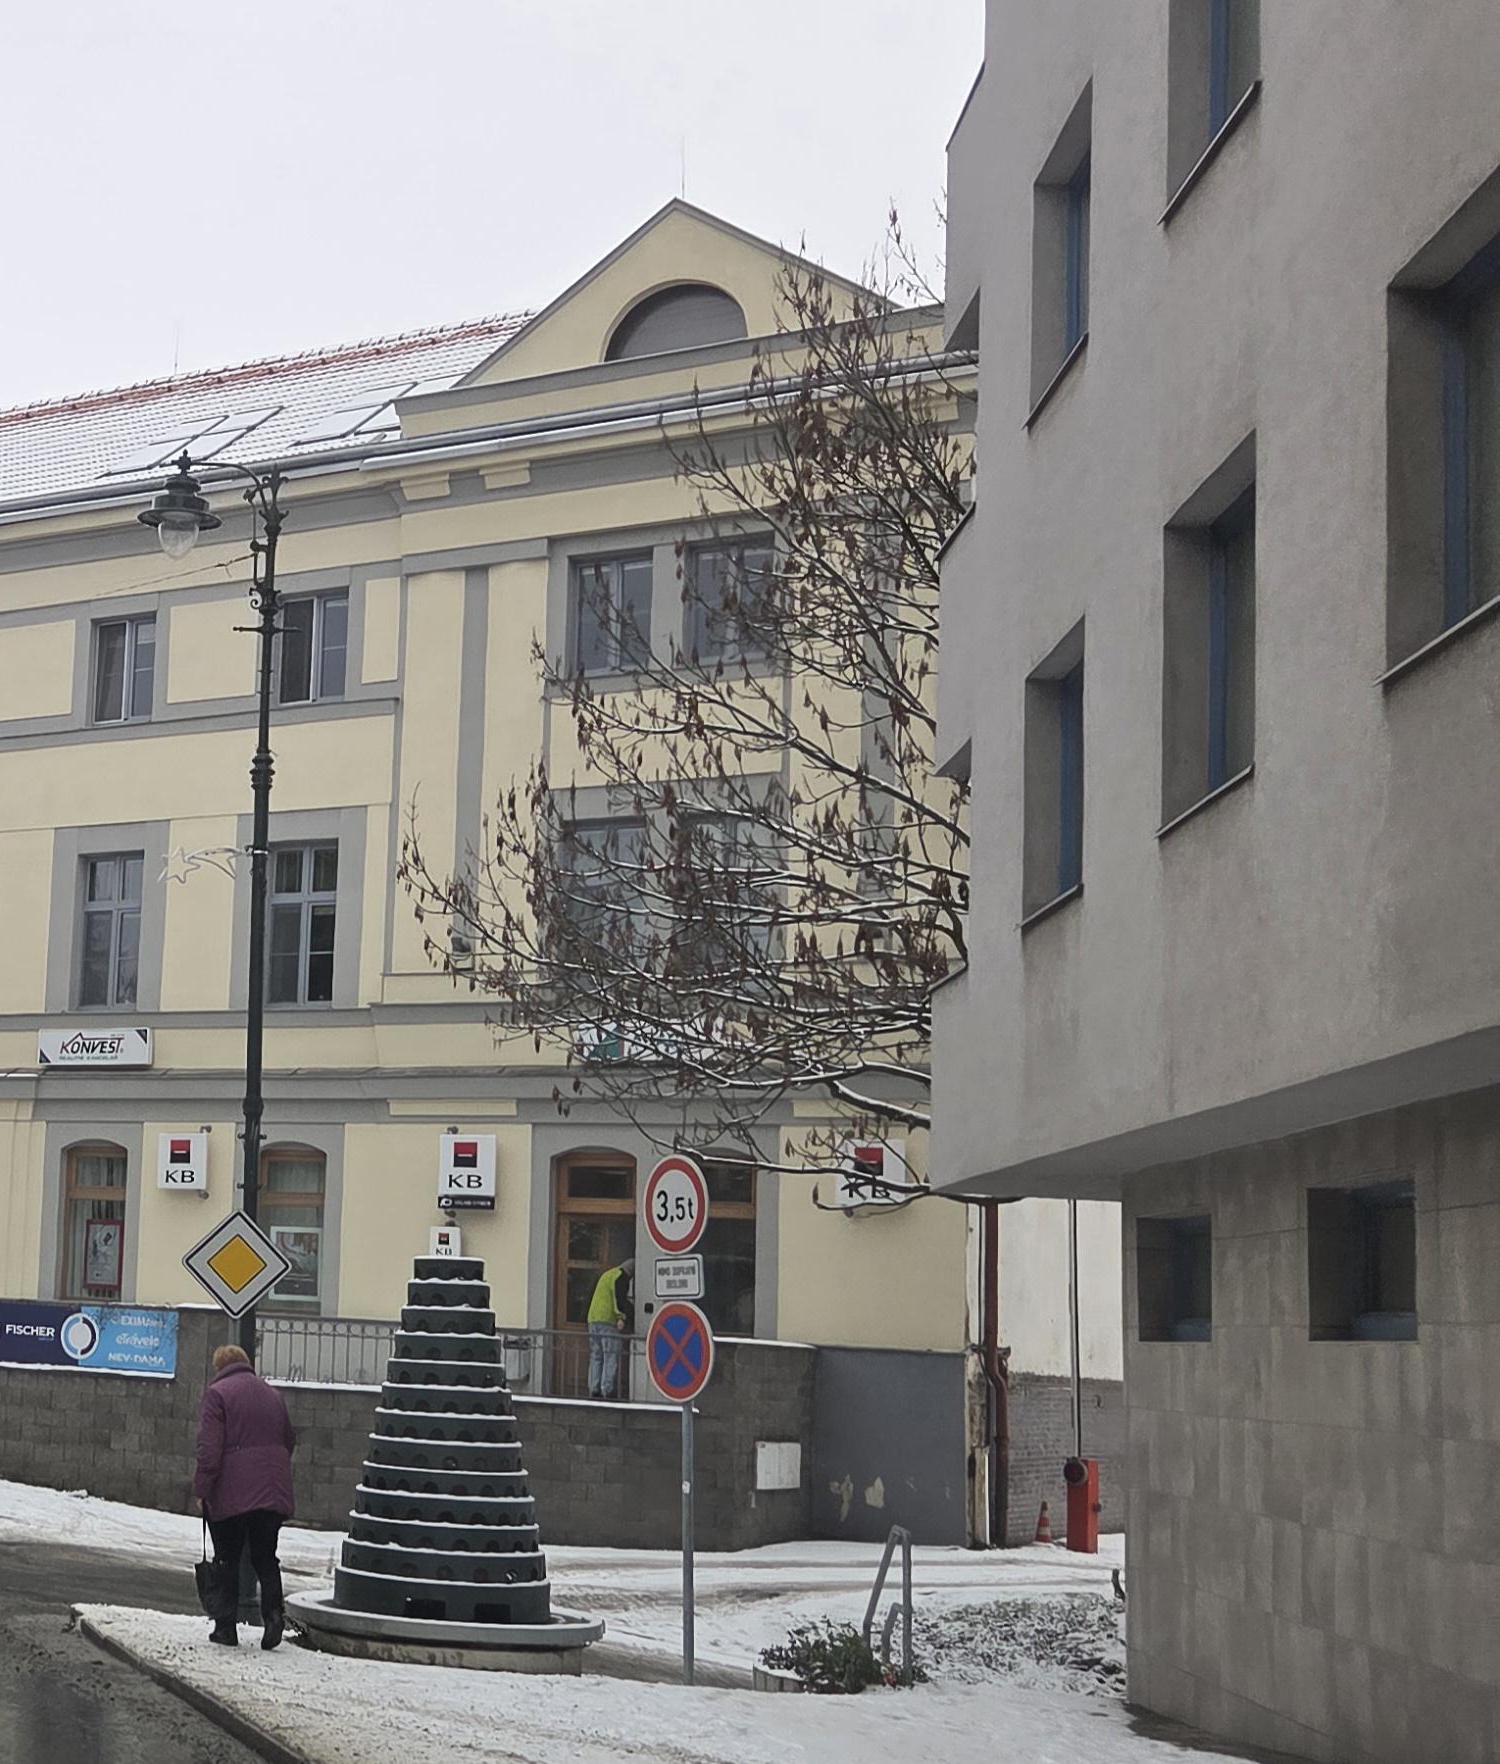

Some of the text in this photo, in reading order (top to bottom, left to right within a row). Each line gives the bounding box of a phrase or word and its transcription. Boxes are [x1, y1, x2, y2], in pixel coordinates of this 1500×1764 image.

[60, 1032, 124, 1054] KONVEST
[165, 1170, 195, 1183] KB
[448, 1174, 482, 1188] KB
[5, 1324, 56, 1337] FISCHER
